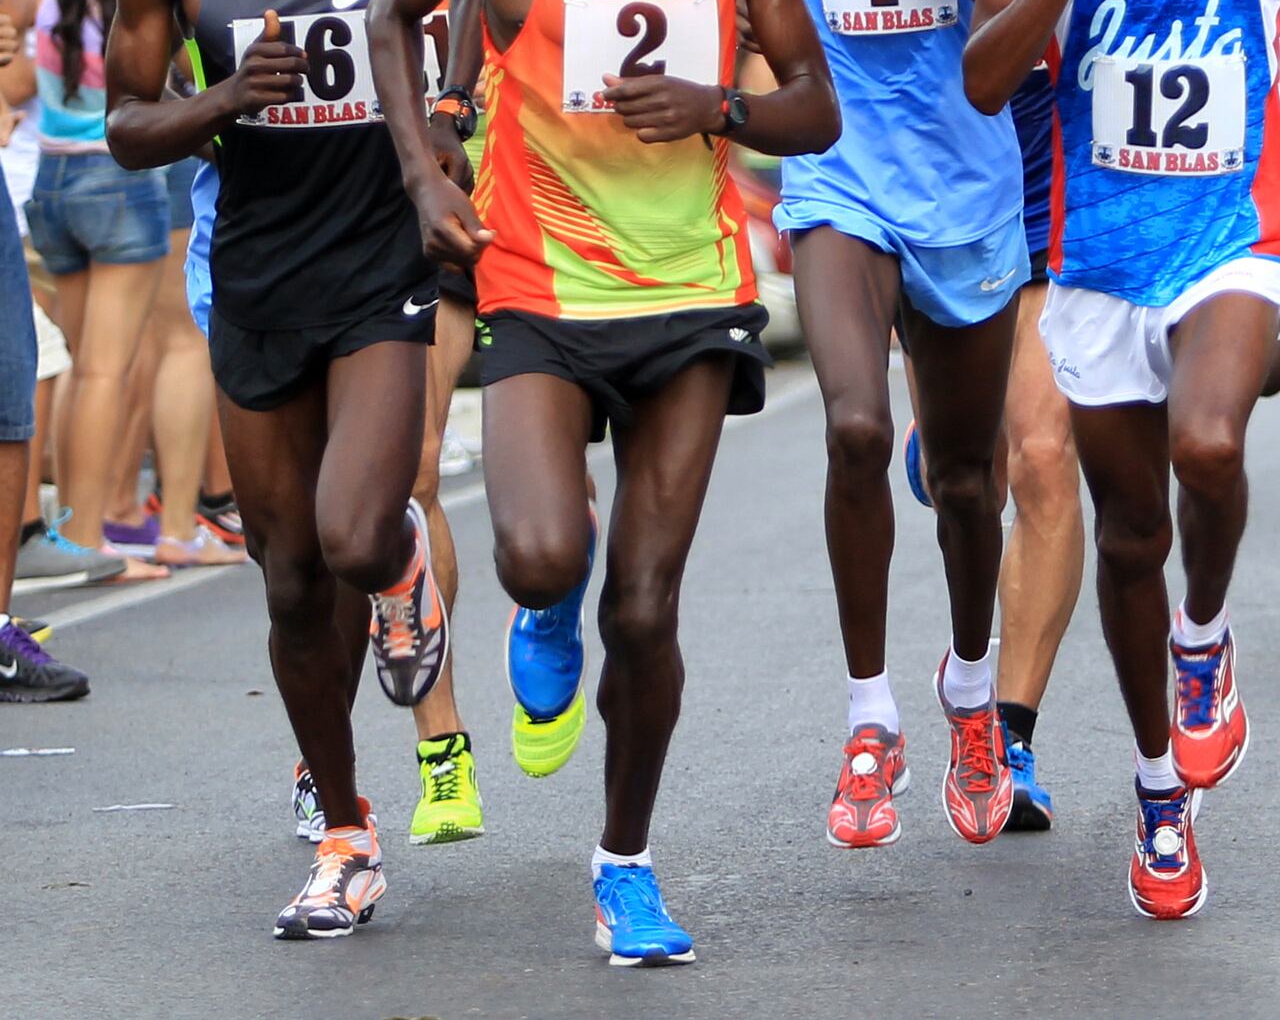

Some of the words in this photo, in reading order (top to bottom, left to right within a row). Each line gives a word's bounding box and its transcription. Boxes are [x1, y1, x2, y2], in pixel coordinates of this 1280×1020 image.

[843, 12, 878, 31] SAN
[882, 8, 934, 30] BLAS
[616, 2, 667, 78] 2
[268, 105, 309, 124] SAN
[313, 101, 366, 123] BLAS
[1125, 63, 1210, 149] 12
[1119, 148, 1161, 171] SAN
[1164, 153, 1219, 172] BLAS
